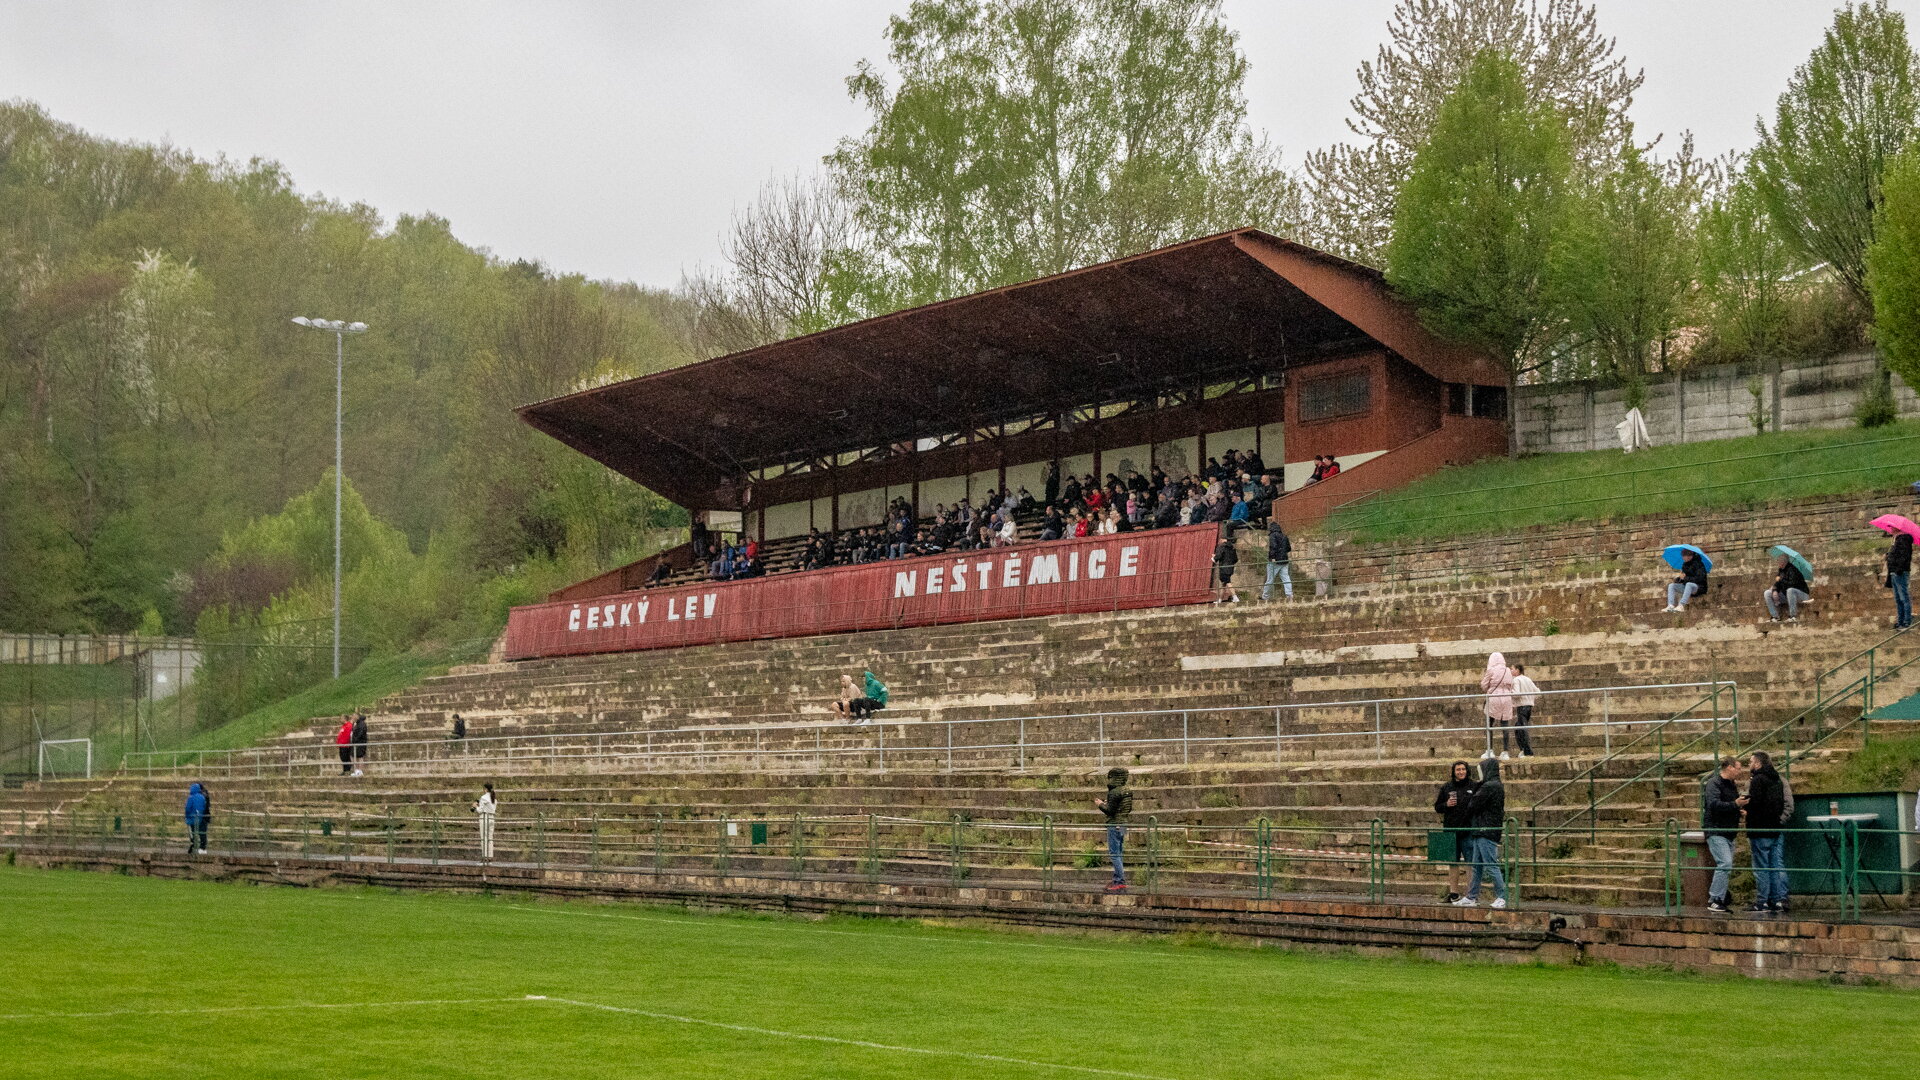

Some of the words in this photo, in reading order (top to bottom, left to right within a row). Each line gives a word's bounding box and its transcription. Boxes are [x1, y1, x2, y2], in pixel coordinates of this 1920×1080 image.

[568, 596, 650, 632] ČESKÝ
[667, 593, 717, 621] LEV
[894, 545, 1140, 598] NEŠTĚMICE
